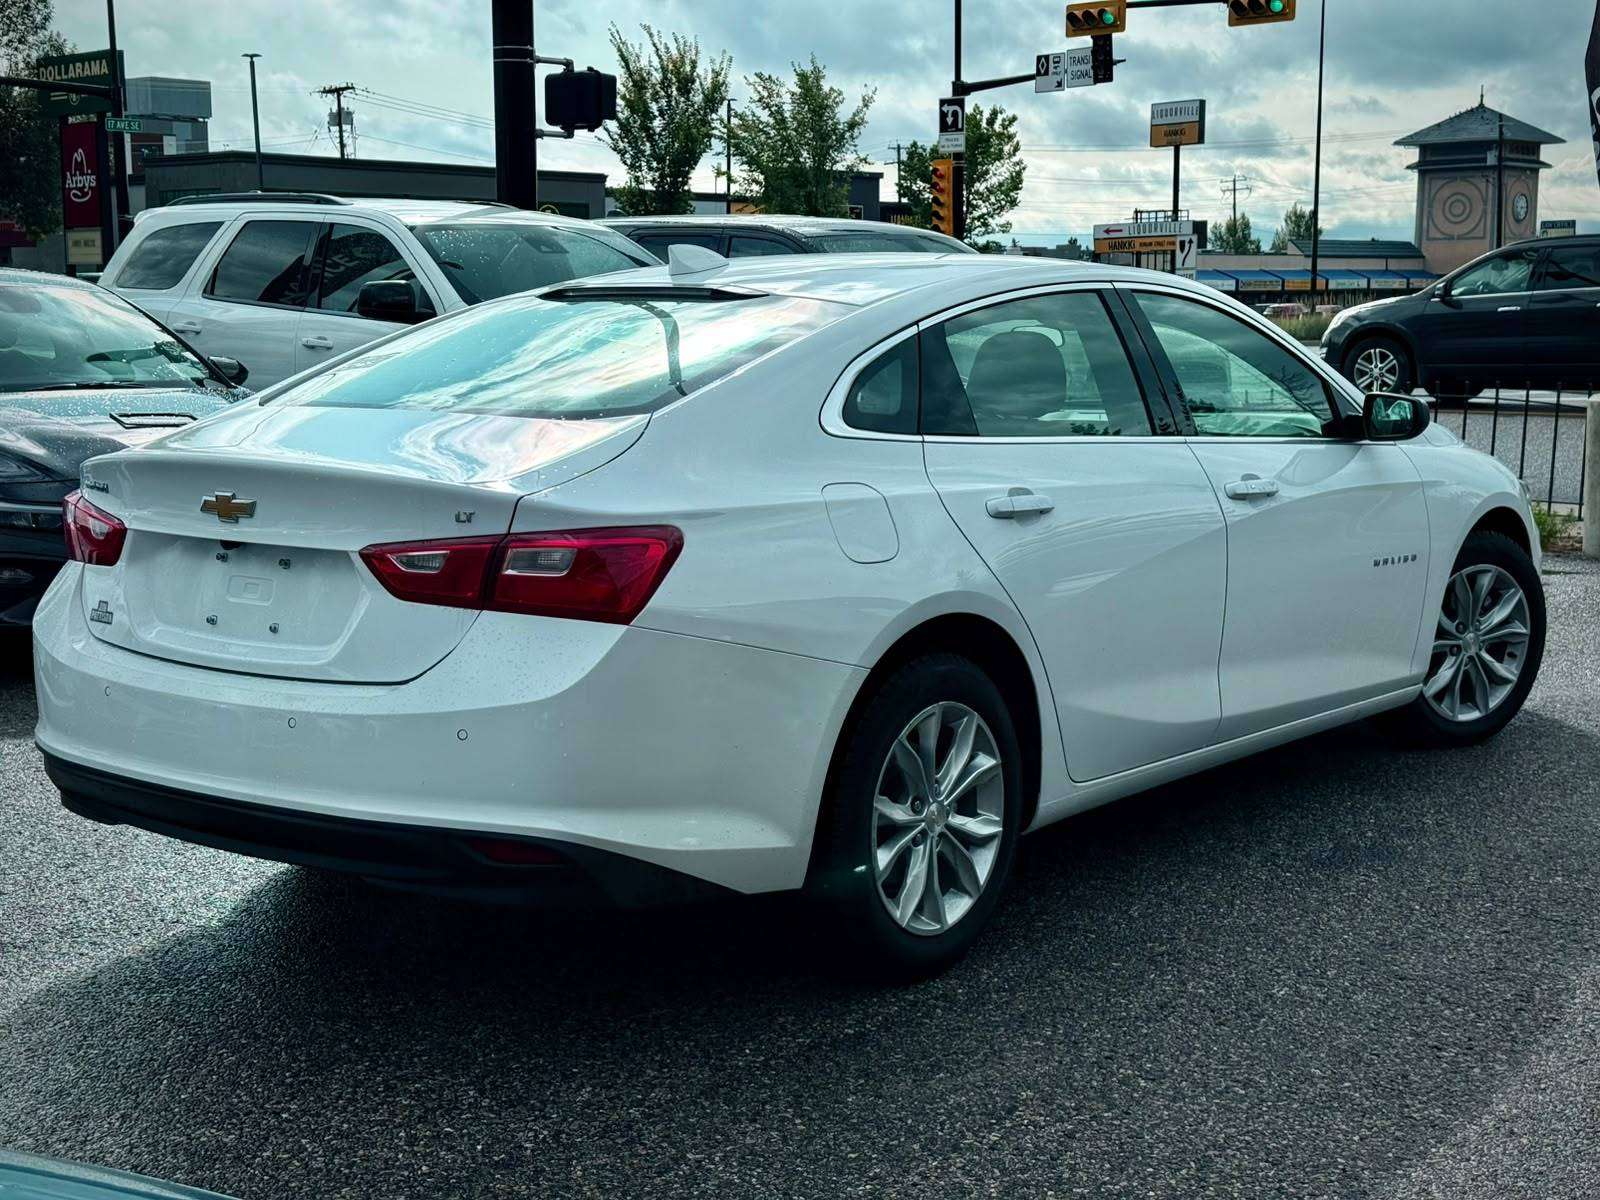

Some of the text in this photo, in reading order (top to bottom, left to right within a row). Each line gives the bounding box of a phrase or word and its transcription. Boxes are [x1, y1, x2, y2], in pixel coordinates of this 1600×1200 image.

[1069, 53, 1092, 67] TRANSI
[39, 58, 109, 81] DOLLARAMA
[1070, 68, 1092, 81] SIGNAL
[1151, 105, 1199, 120] LIQUORVILLE
[107, 120, 140, 130] 17 AVE SE
[65, 169, 97, 192] Arby's
[1128, 221, 1183, 236] LIQUORVILLE
[455, 510, 476, 524] LT
